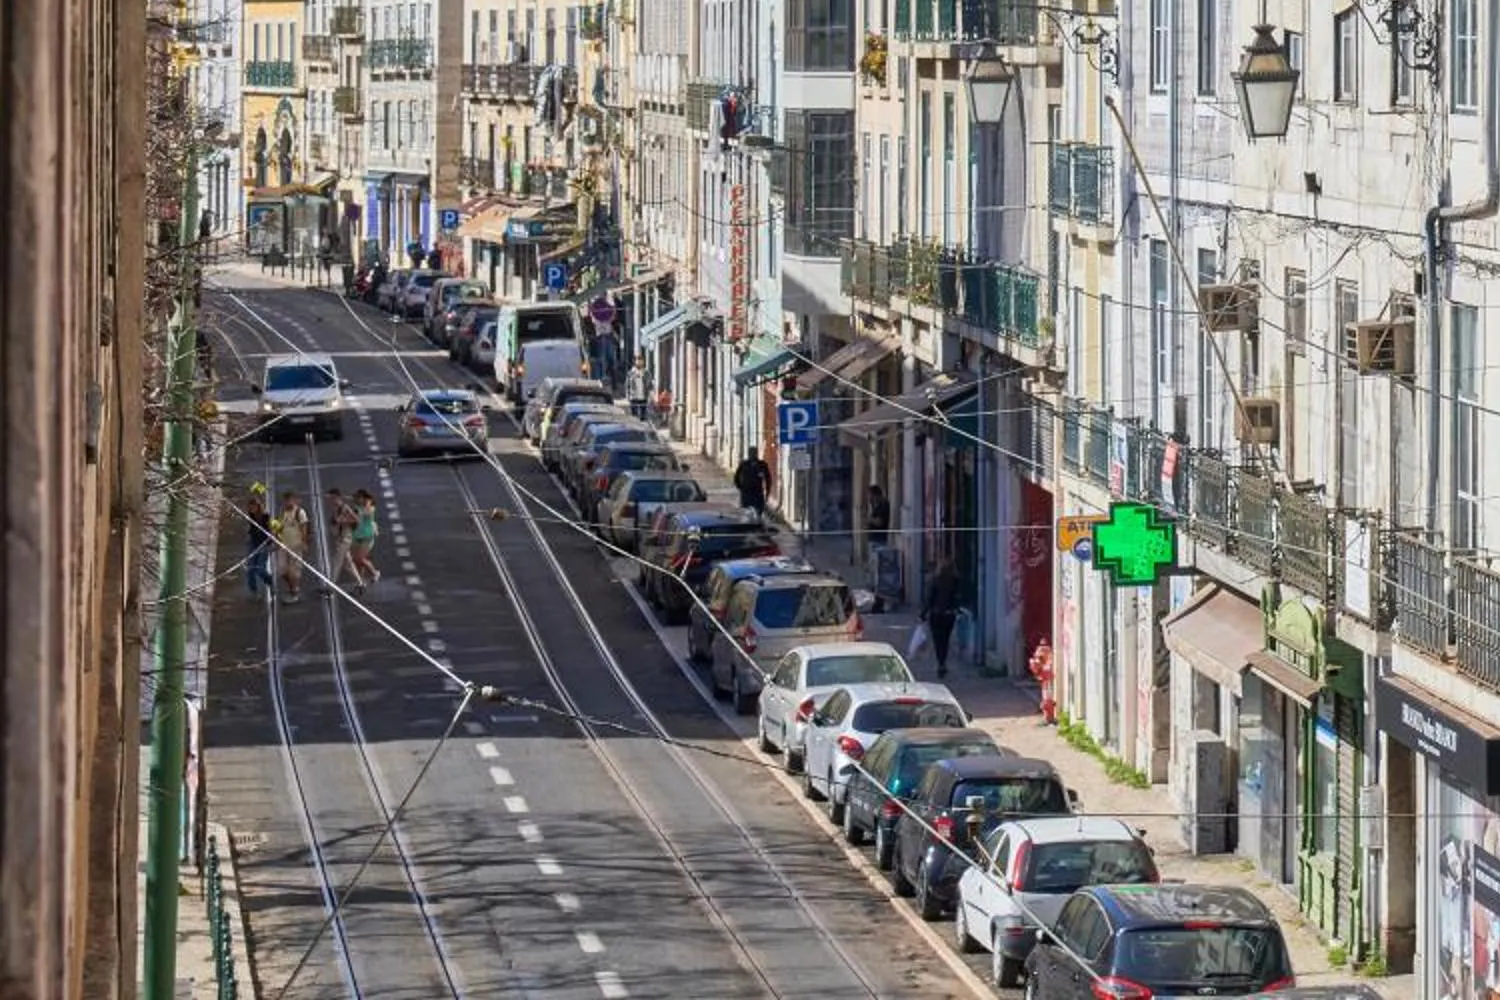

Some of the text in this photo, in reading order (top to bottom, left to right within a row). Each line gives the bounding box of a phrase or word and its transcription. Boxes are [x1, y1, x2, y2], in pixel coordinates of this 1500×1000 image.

[444, 211, 457, 226] P
[548, 267, 561, 286] P
[787, 407, 809, 439] P
